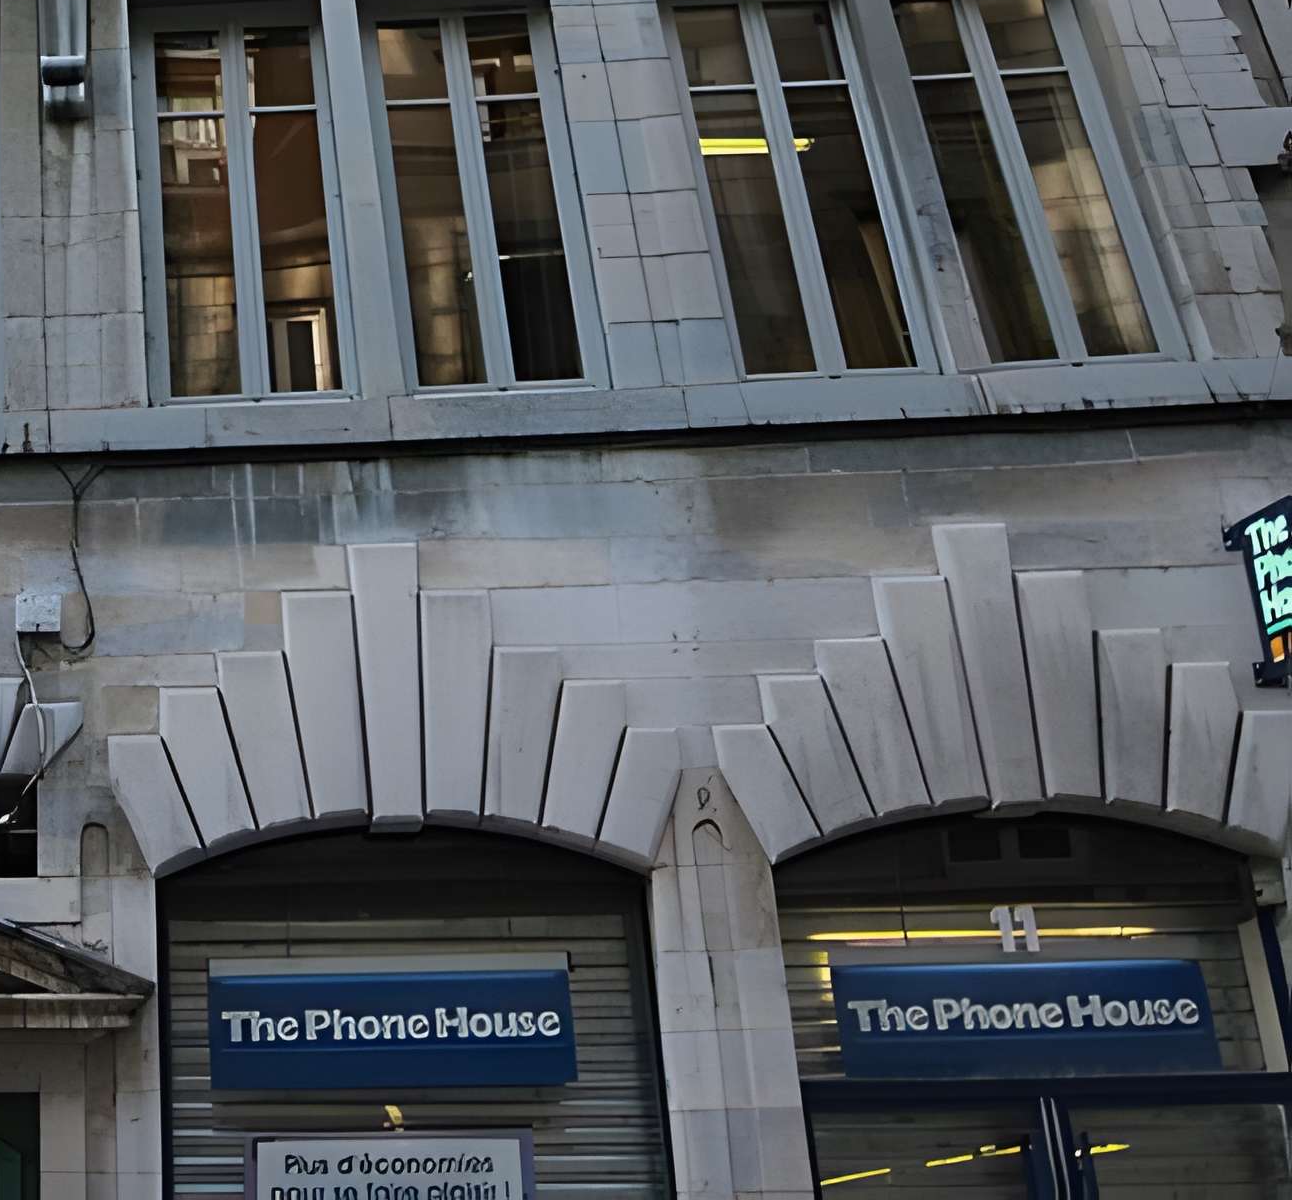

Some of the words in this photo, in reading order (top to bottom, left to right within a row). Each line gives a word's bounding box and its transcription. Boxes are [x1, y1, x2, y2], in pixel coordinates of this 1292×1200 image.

[1244, 514, 1288, 556] The
[990, 904, 1040, 953] 11
[221, 1010, 299, 1043] The
[304, 1008, 430, 1041] Phone
[435, 1006, 561, 1039] House
[847, 999, 929, 1032] The
[933, 997, 1064, 1031] Phone
[1066, 994, 1200, 1029] House
